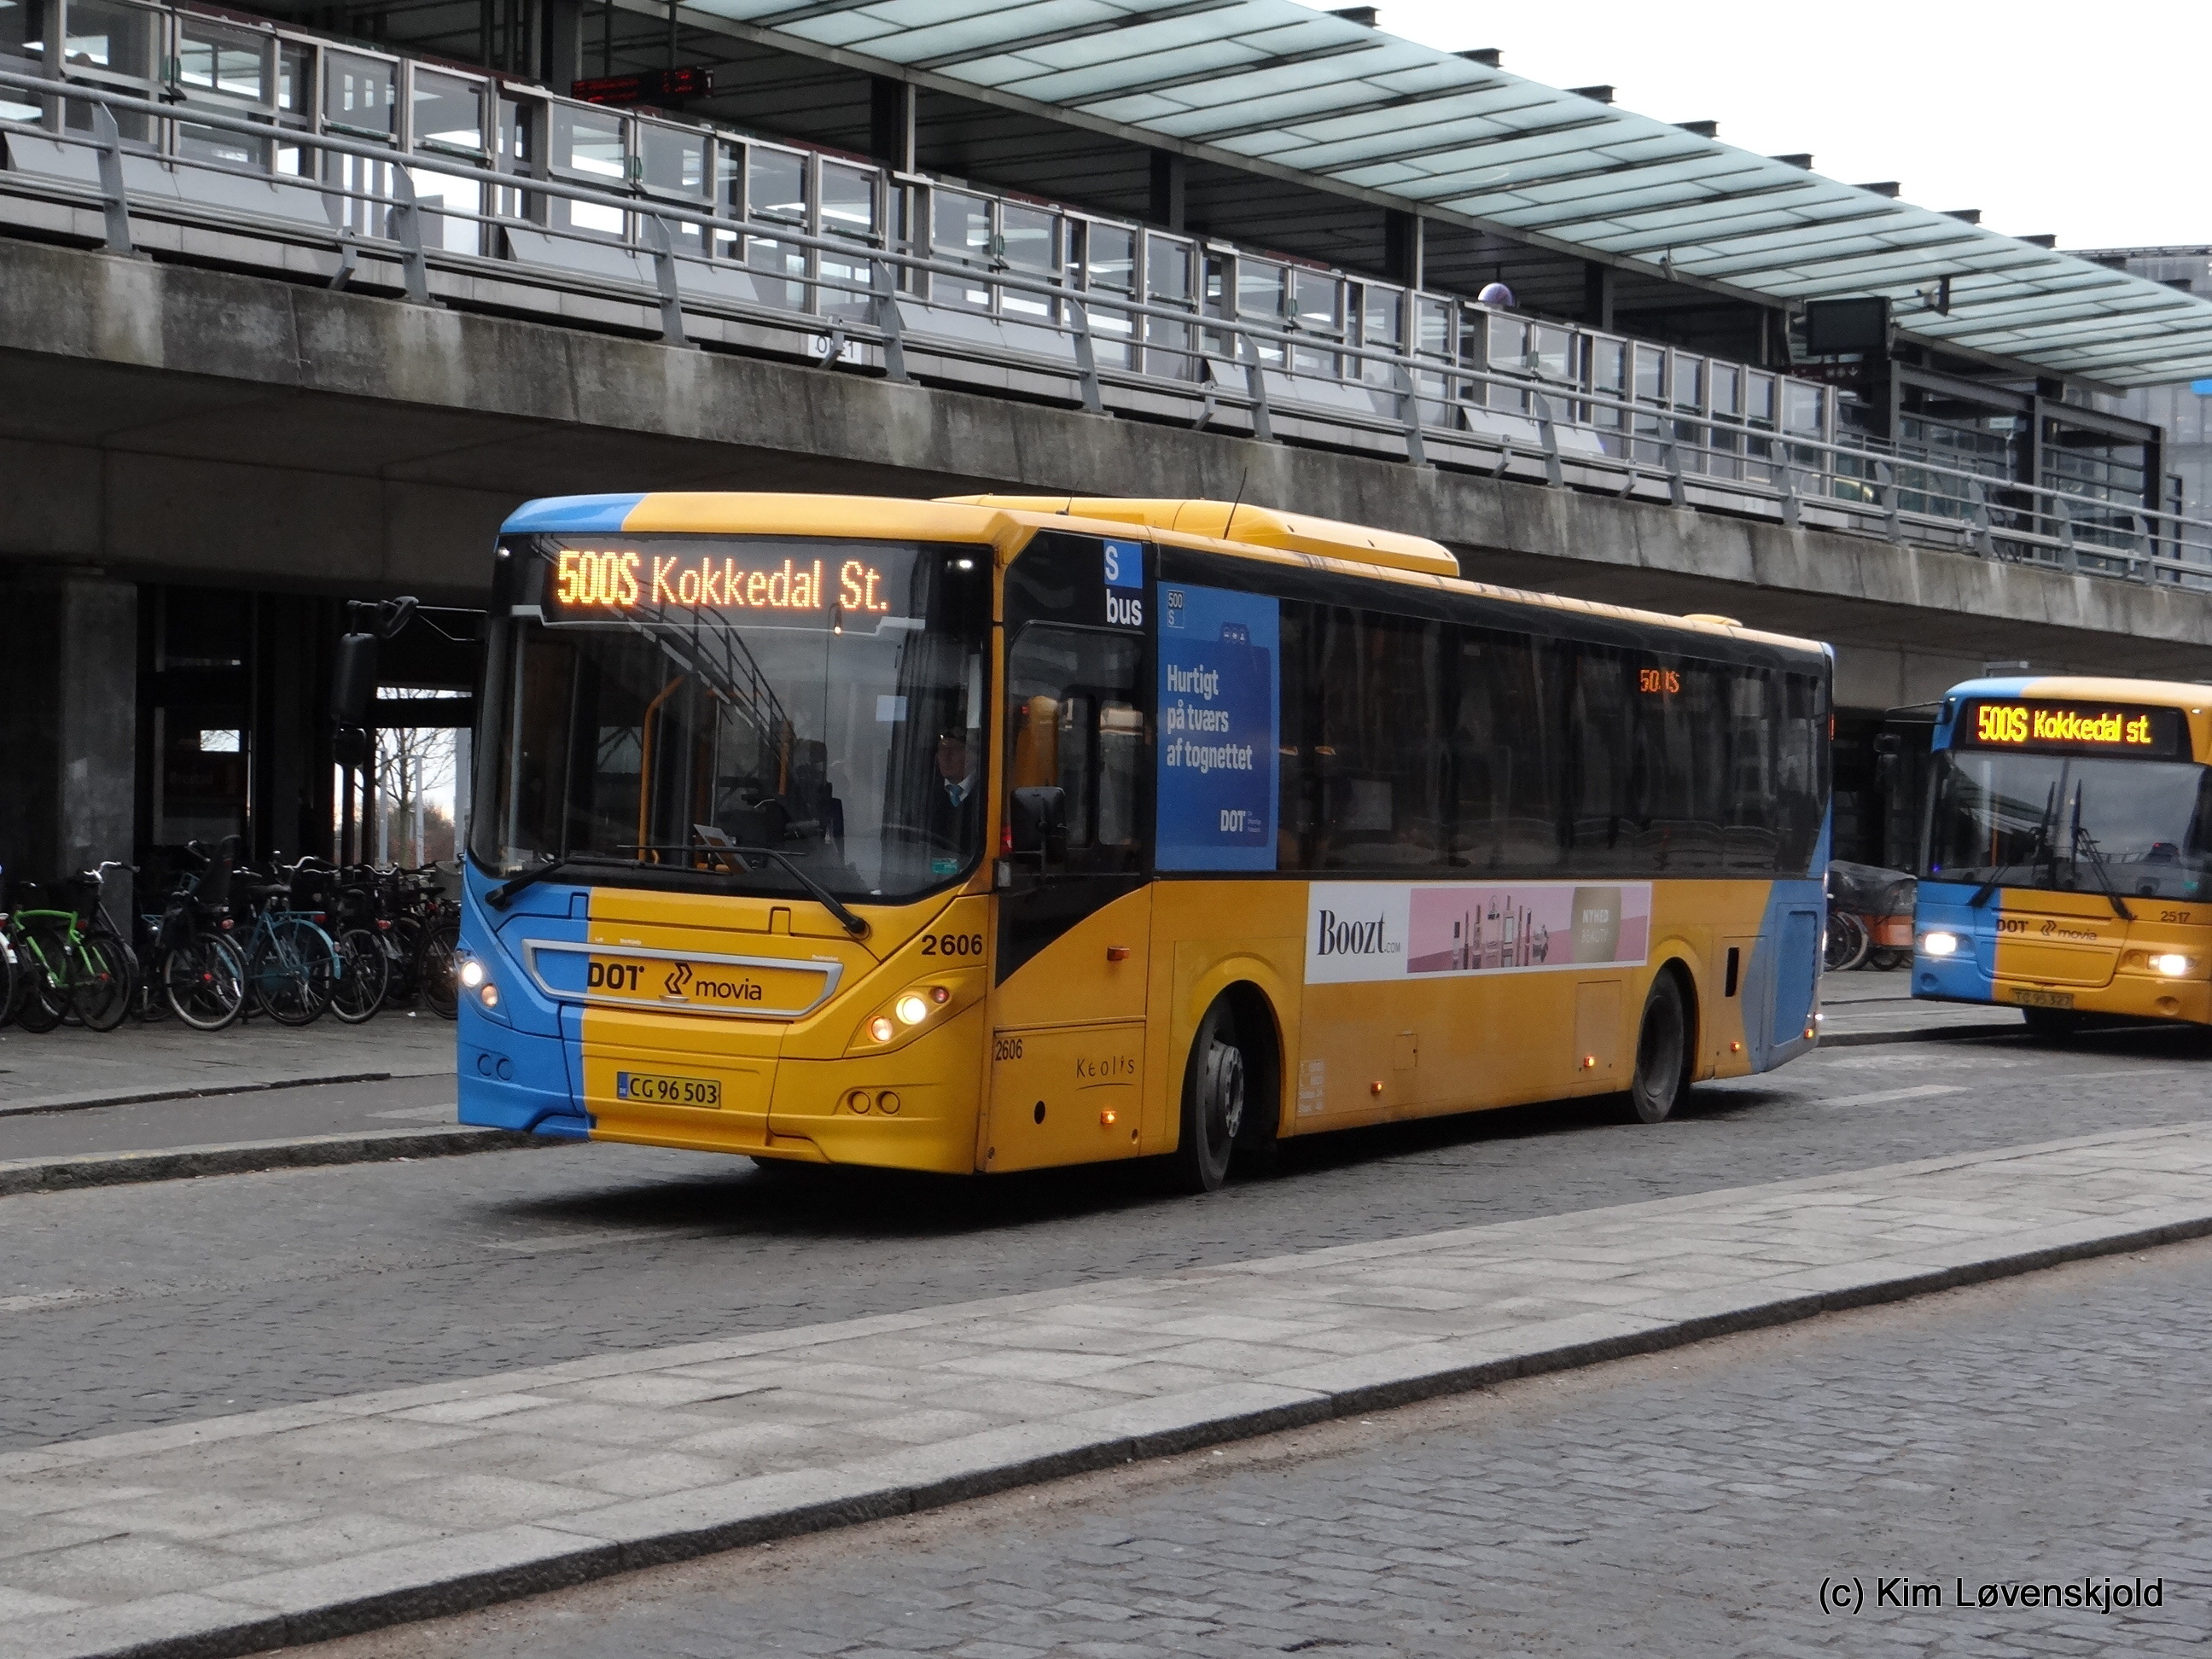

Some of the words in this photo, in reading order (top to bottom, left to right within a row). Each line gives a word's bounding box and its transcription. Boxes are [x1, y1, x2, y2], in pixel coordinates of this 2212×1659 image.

[1105, 545, 1119, 580] S
[556, 550, 640, 605] 500S
[652, 556, 820, 608] Kokkedal
[840, 560, 888, 610] St.
[1106, 588, 1143, 626] bus
[1168, 592, 1183, 608] 500
[1167, 609, 1175, 625] S
[1167, 664, 1219, 701] Hurtigt
[1167, 698, 1185, 735] på
[1187, 703, 1230, 733] tværs
[1978, 706, 2029, 742] 500S
[2034, 710, 2122, 742] Kokkedal
[1167, 737, 1183, 767] af
[1185, 740, 1253, 774] tognettet
[1220, 809, 1246, 832] DOT
[1996, 918, 2029, 934] DOT
[2058, 928, 2098, 941] movia
[2160, 910, 2191, 923] 2517
[922, 934, 983, 956] 2606
[588, 962, 644, 991] DOT
[696, 978, 762, 1001] movia
[995, 1039, 1022, 1061] 2606
[630, 1078, 654, 1098] CG
[658, 1080, 679, 1100] 96
[684, 1083, 717, 1103] 503
